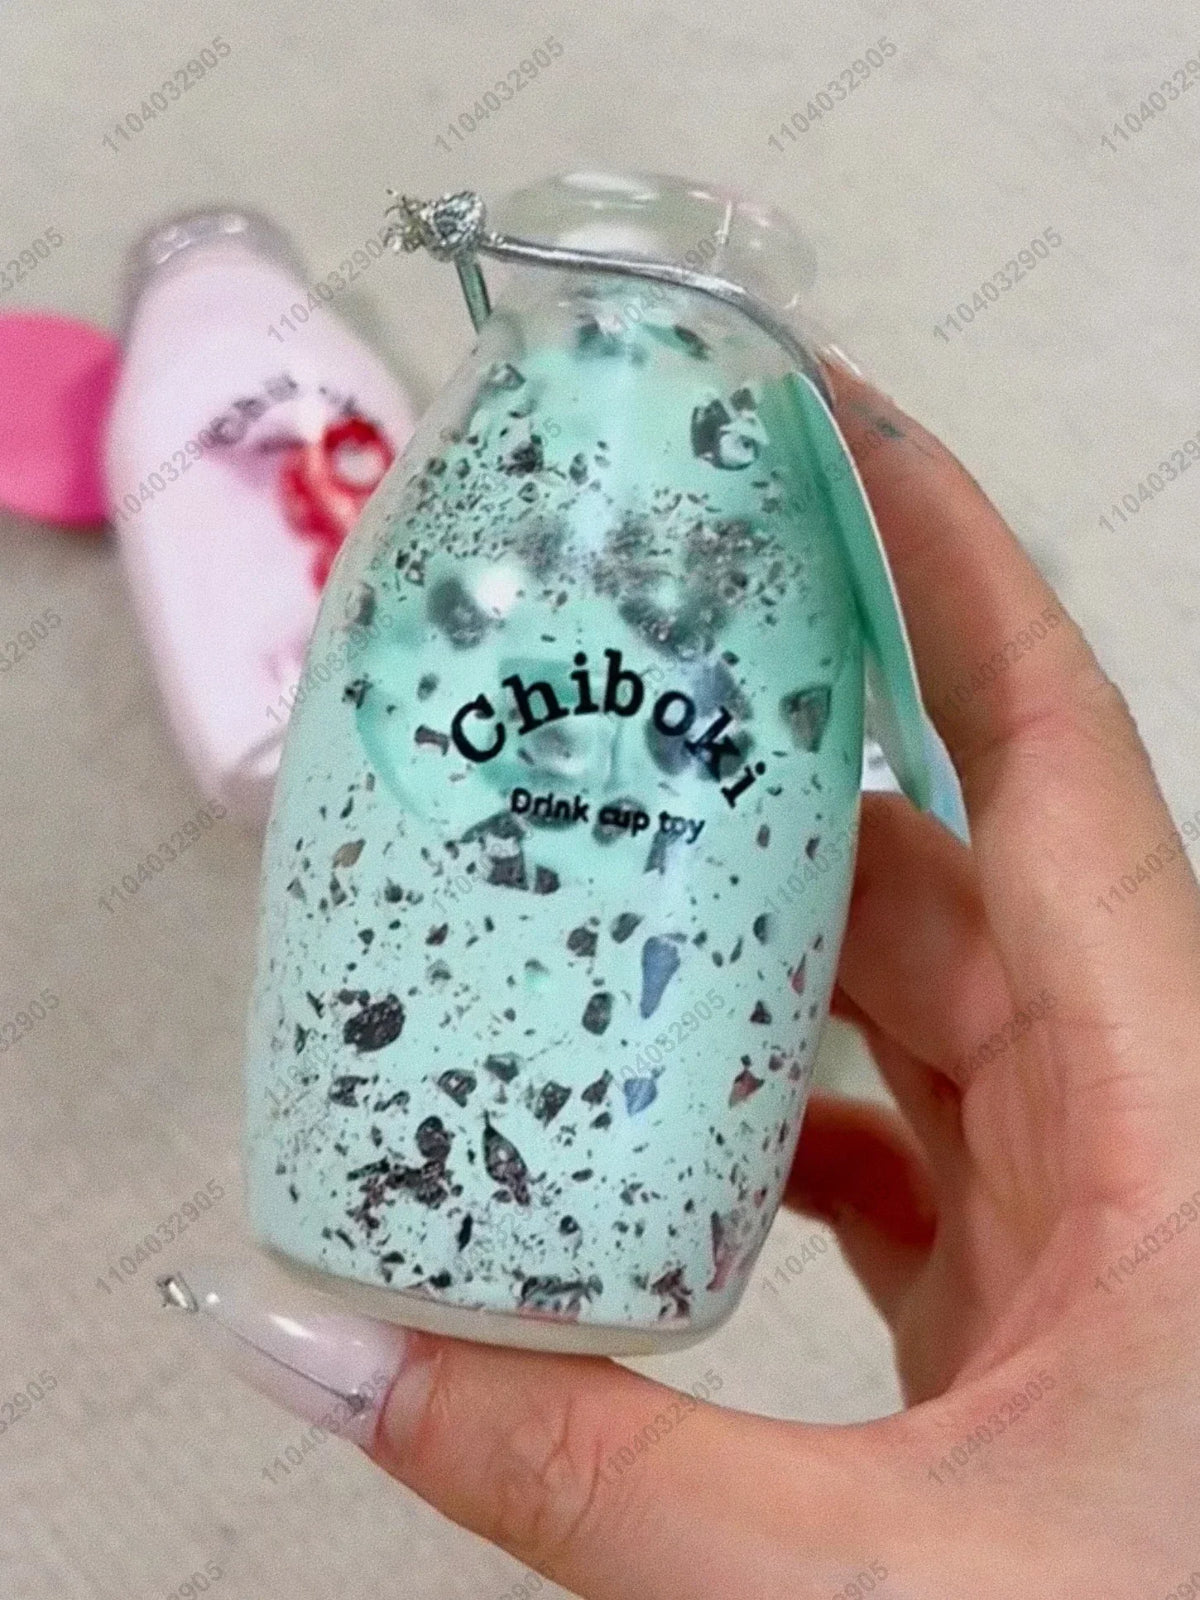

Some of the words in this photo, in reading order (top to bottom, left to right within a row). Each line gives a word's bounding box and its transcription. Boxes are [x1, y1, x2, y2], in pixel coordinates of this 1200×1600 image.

[450, 648, 766, 809] Chiboki
[509, 787, 589, 823] Drink
[599, 807, 651, 837] cup
[659, 810, 706, 844] toy
